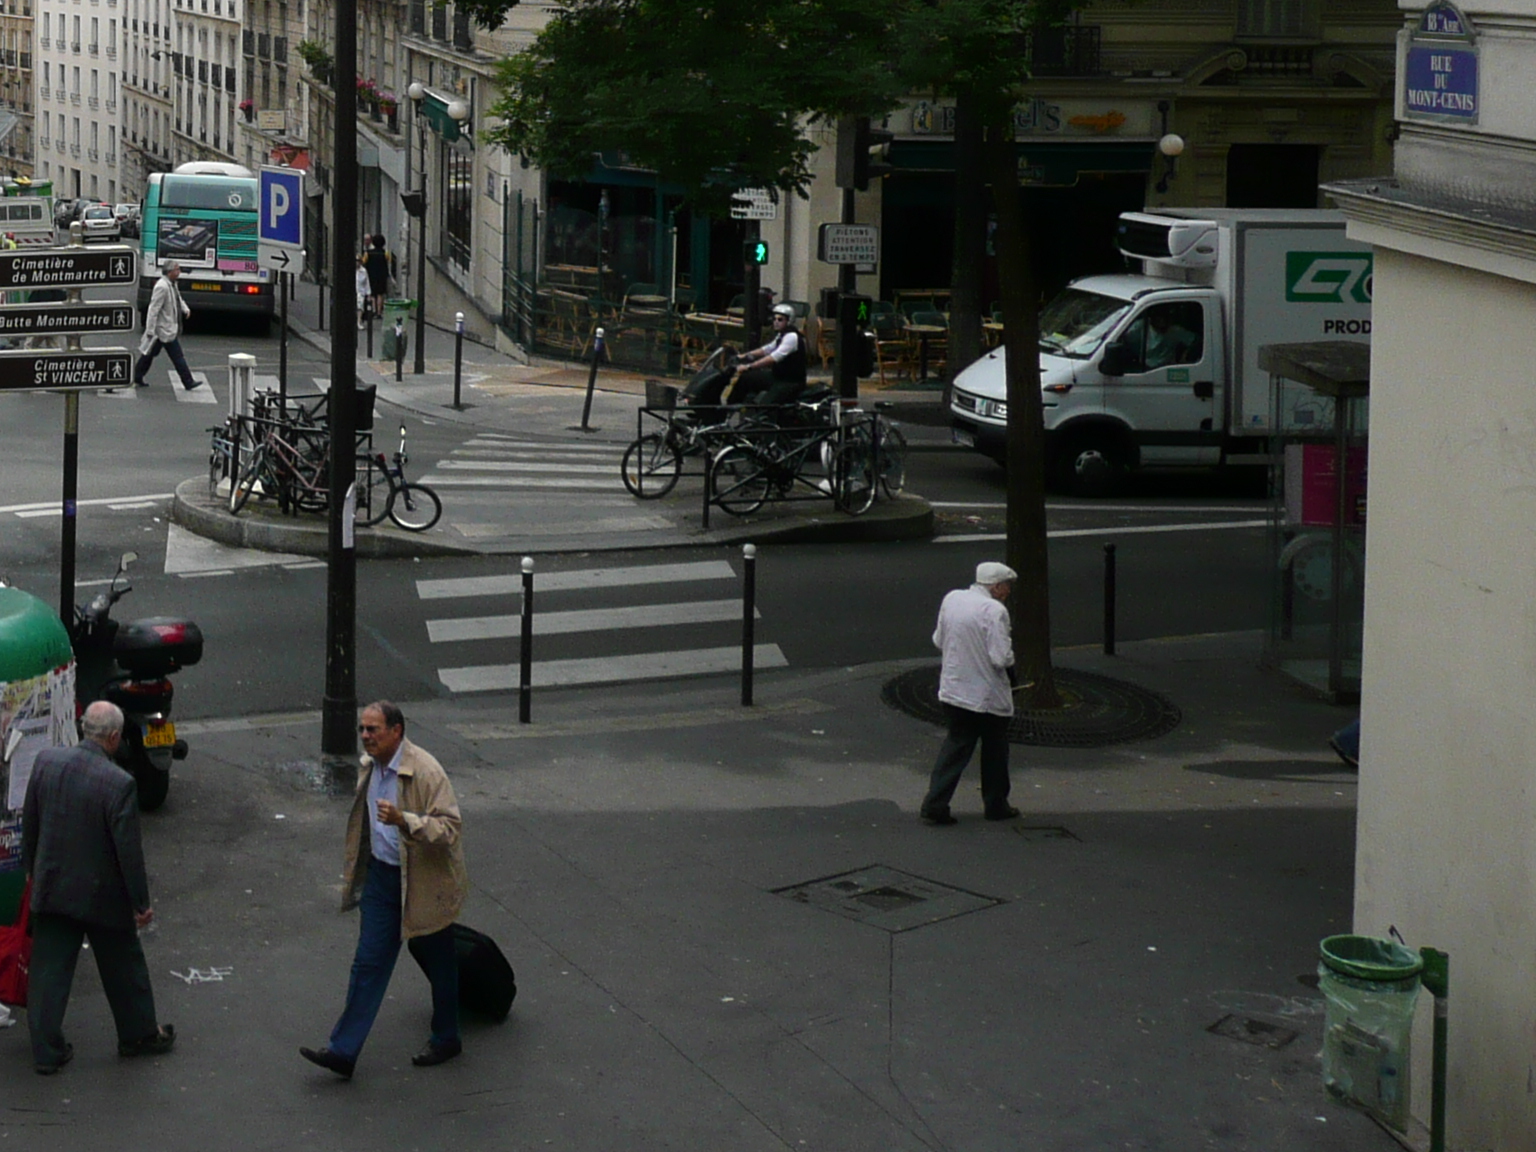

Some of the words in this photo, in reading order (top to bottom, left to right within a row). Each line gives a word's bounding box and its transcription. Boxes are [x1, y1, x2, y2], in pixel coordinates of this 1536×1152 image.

[1430, 55, 1452, 72] RUE
[1434, 73, 1448, 90] DU
[1408, 89, 1474, 111] MONT-CENIS
[270, 182, 290, 229] P
[830, 245, 875, 253] TRAVERSEZ
[12, 257, 74, 271] Cimetière
[849, 253, 875, 261] TEMPS
[244, 261, 257, 271] 80
[12, 272, 27, 283] de
[31, 269, 107, 283] Montmartre
[36, 313, 110, 327] Montmartre
[34, 358, 95, 372] Cimetière
[34, 371, 48, 385] St
[52, 370, 105, 384] VINCENT
